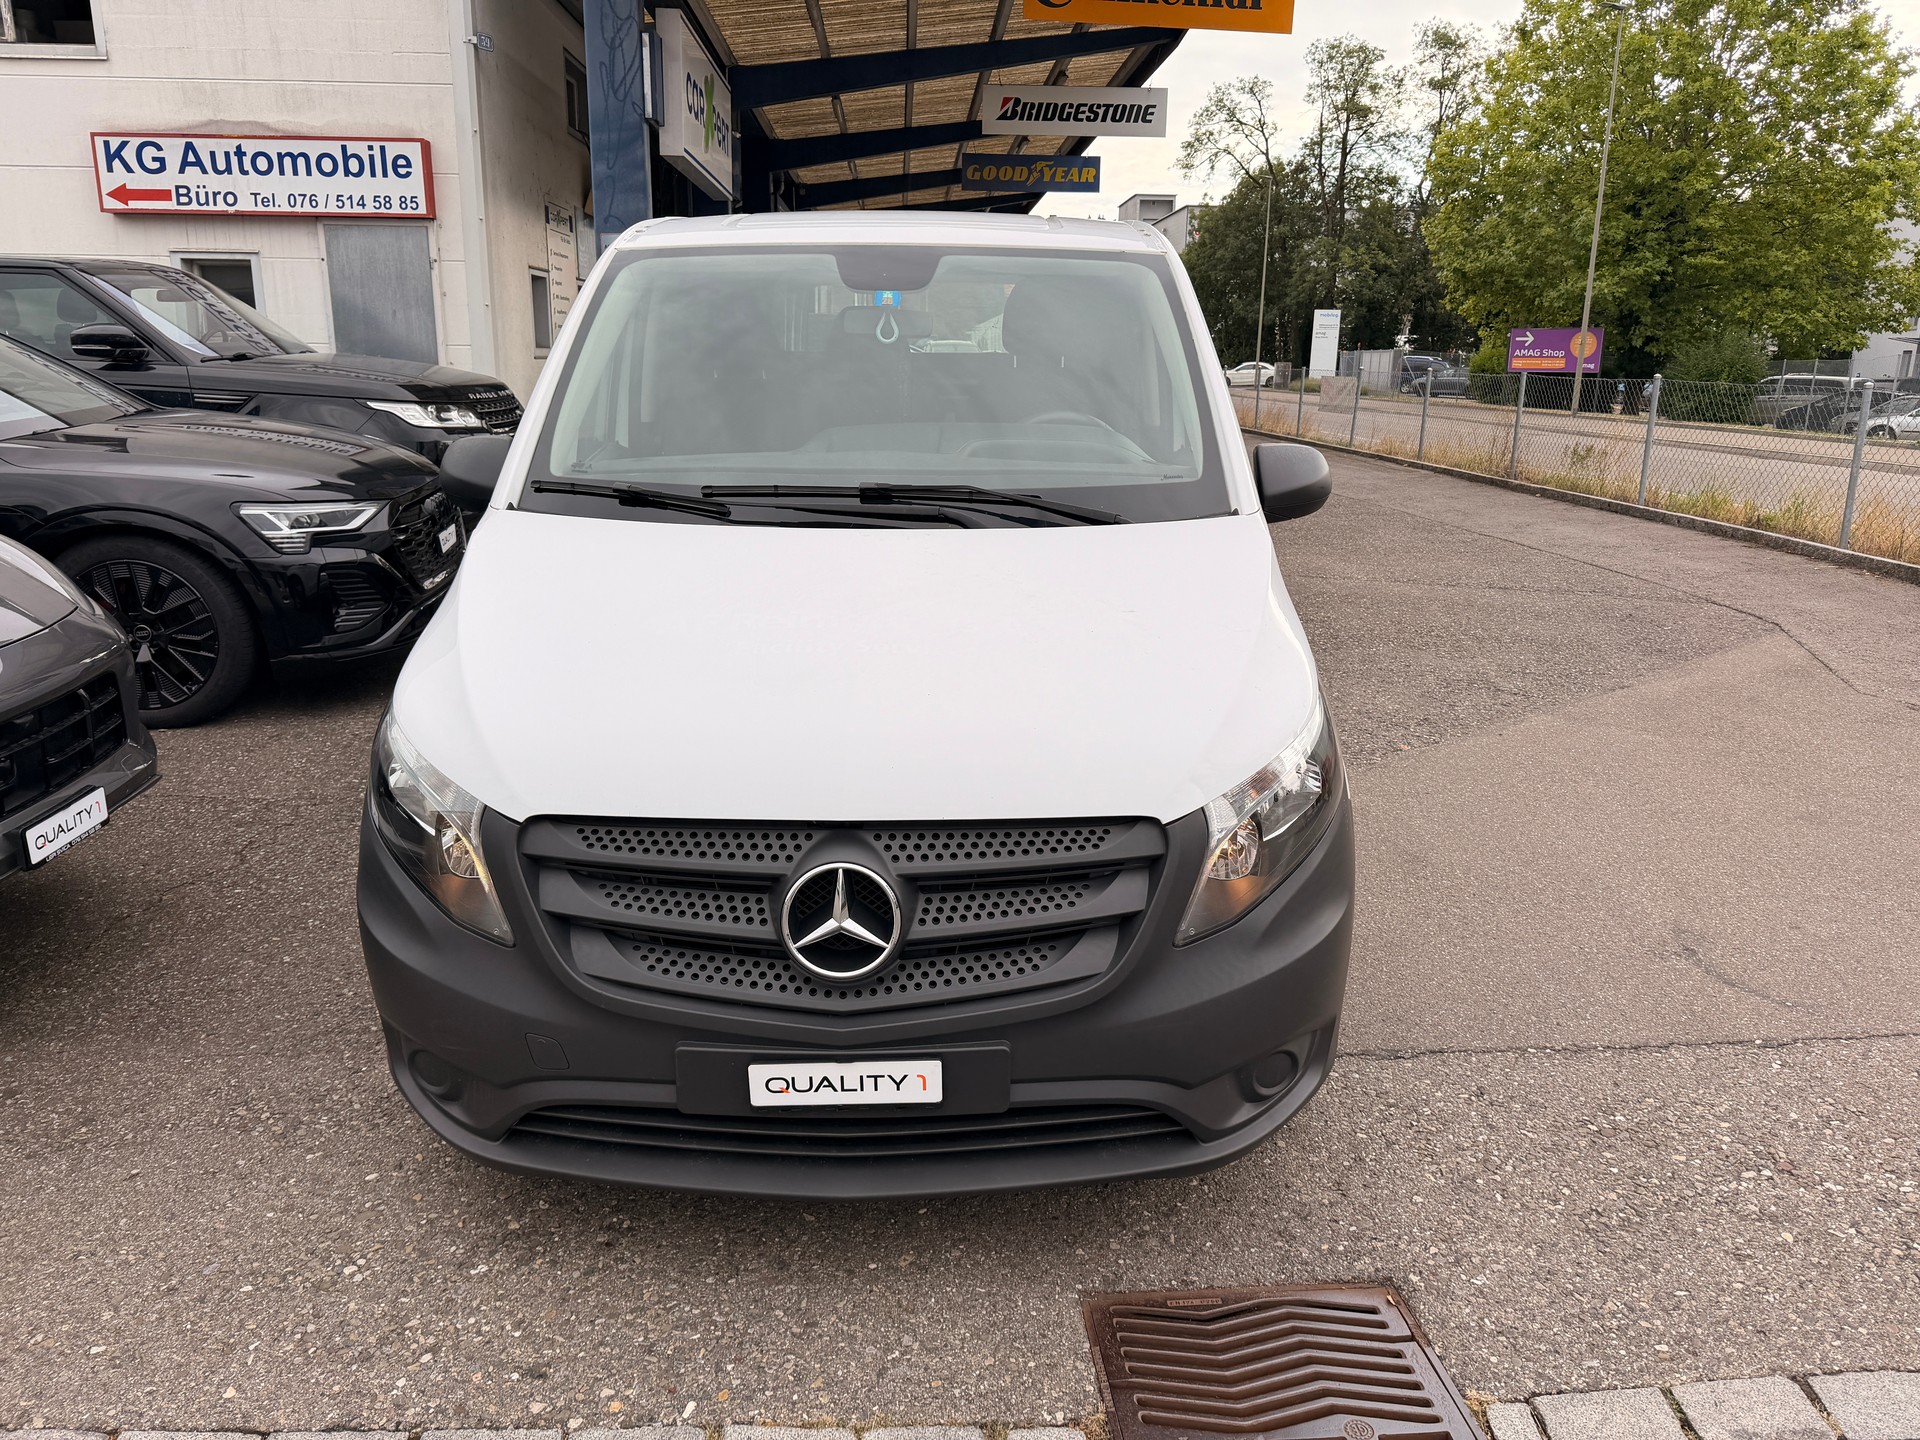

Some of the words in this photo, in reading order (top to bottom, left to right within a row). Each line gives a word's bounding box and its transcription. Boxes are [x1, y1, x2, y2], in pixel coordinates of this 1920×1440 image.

[996, 97, 1157, 124] BRIDGESTONE
[102, 139, 167, 175] KG
[178, 141, 413, 179] Automobile
[174, 184, 238, 207] Büro
[250, 192, 282, 208] Tel.
[287, 193, 318, 209] 076
[335, 194, 366, 210] 514
[373, 195, 393, 210] 58
[399, 195, 419, 211] 85
[1514, 349, 1540, 357] AMAG
[1542, 349, 1565, 358] Shop
[468, 391, 498, 400] RANGE
[35, 804, 93, 850] QUALITY
[95, 800, 101, 813] 1
[764, 1074, 908, 1094] QUALITY
[916, 1074, 927, 1091] 1
